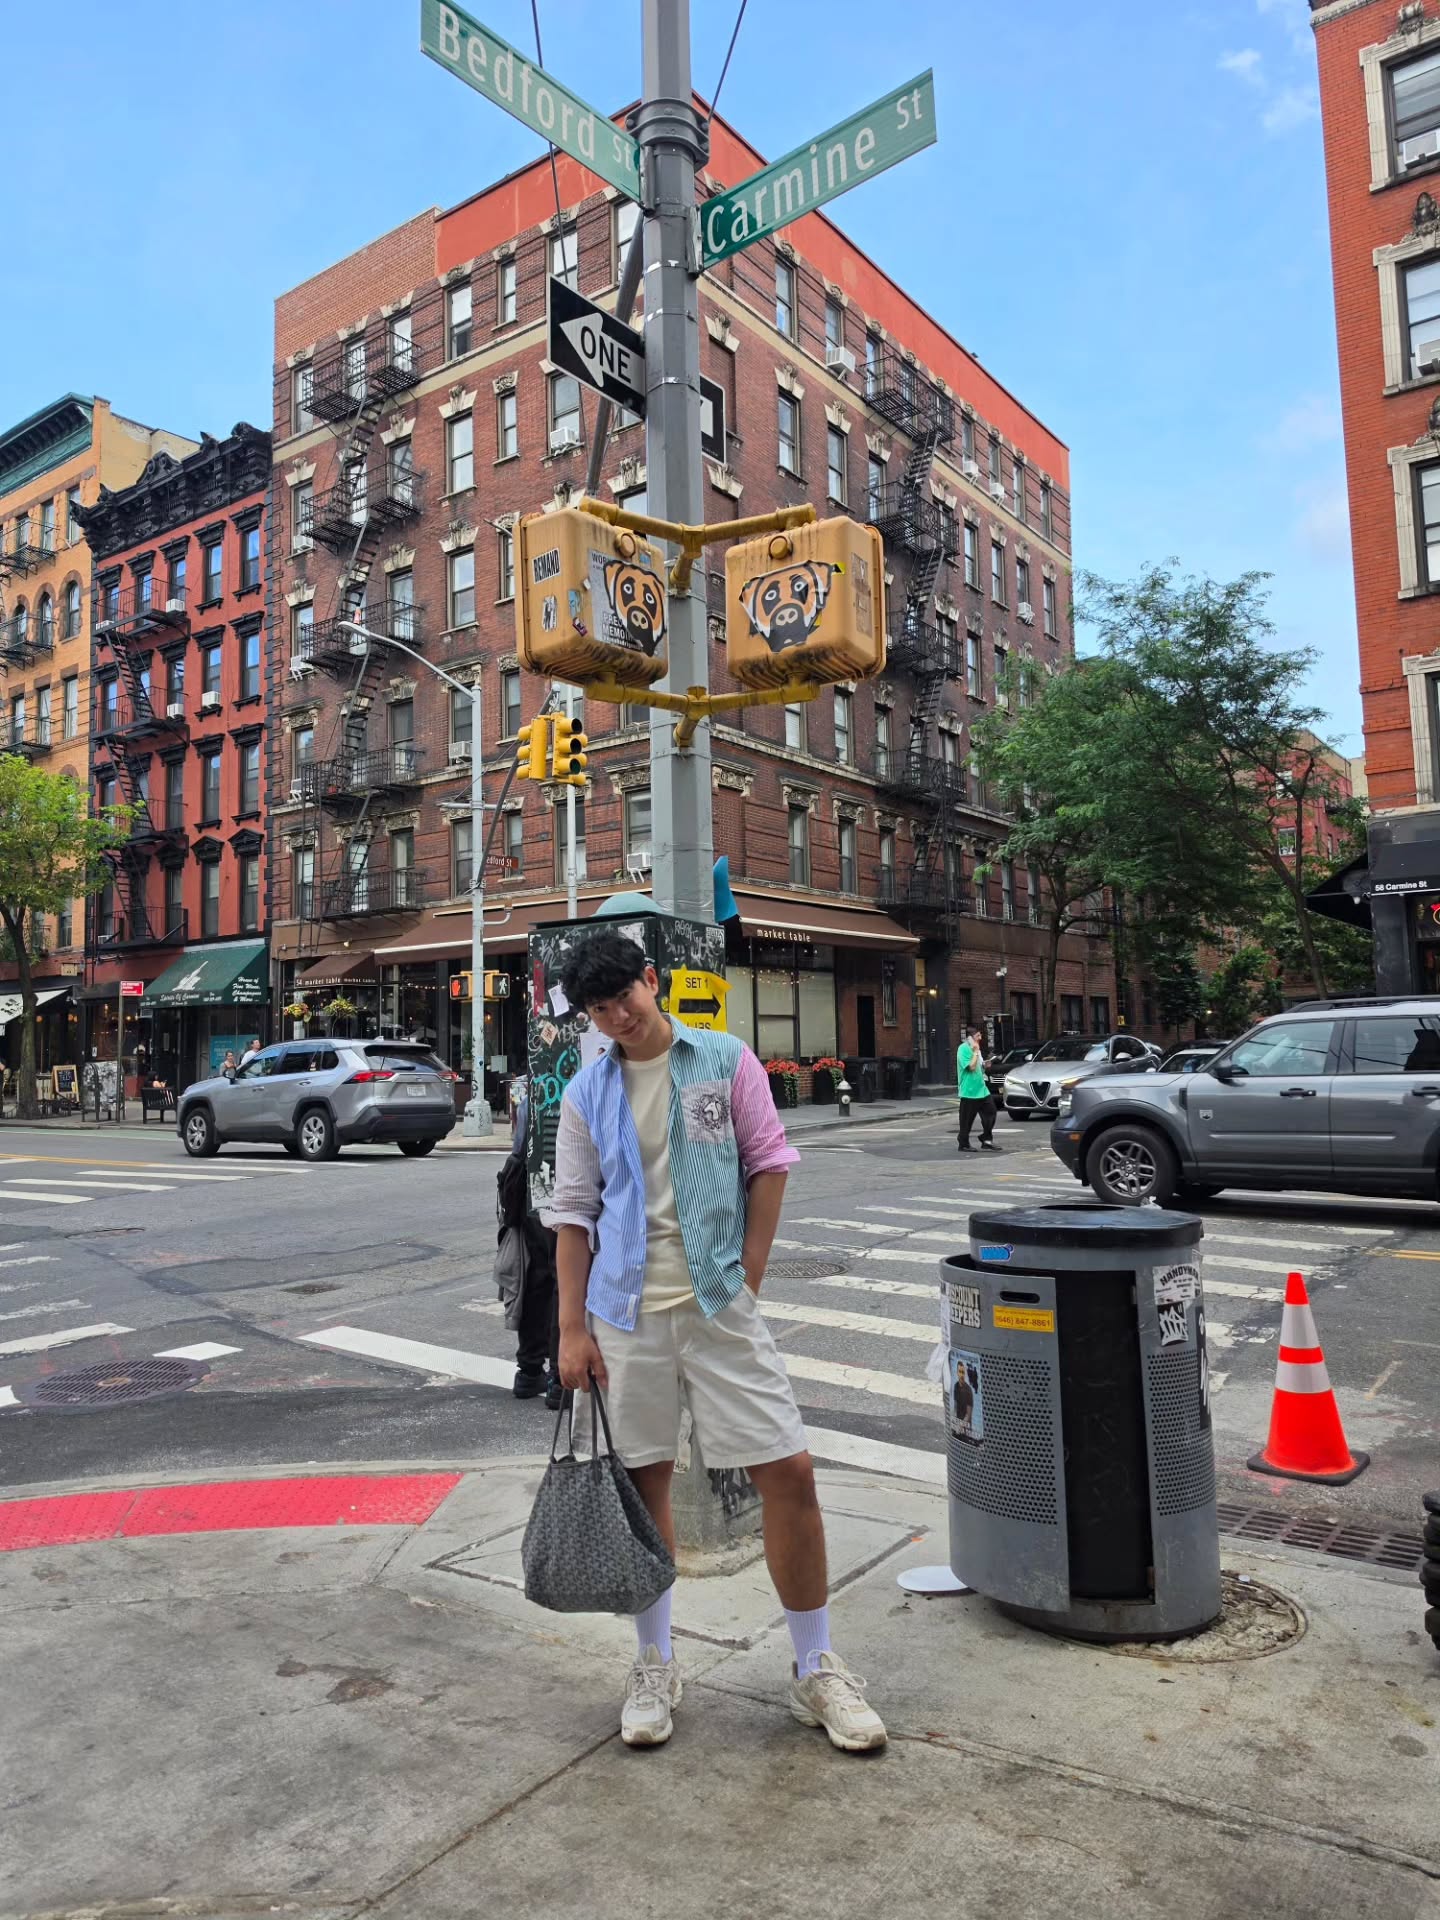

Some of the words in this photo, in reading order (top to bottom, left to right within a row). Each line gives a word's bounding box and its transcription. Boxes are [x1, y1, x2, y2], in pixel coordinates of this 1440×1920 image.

[439, 2, 596, 161] Bedford
[612, 135, 633, 172] St
[707, 127, 876, 254] Carmine
[896, 88, 922, 129] St
[580, 326, 631, 384] ONE
[486, 857, 505, 866] edford
[1385, 882, 1417, 890] Carmine
[757, 928, 786, 940] market
[789, 931, 811, 943] table
[325, 976, 341, 984] table
[685, 977, 702, 988] SET
[704, 977, 709, 989] 1
[1160, 1266, 1199, 1286] HANDYMAN
